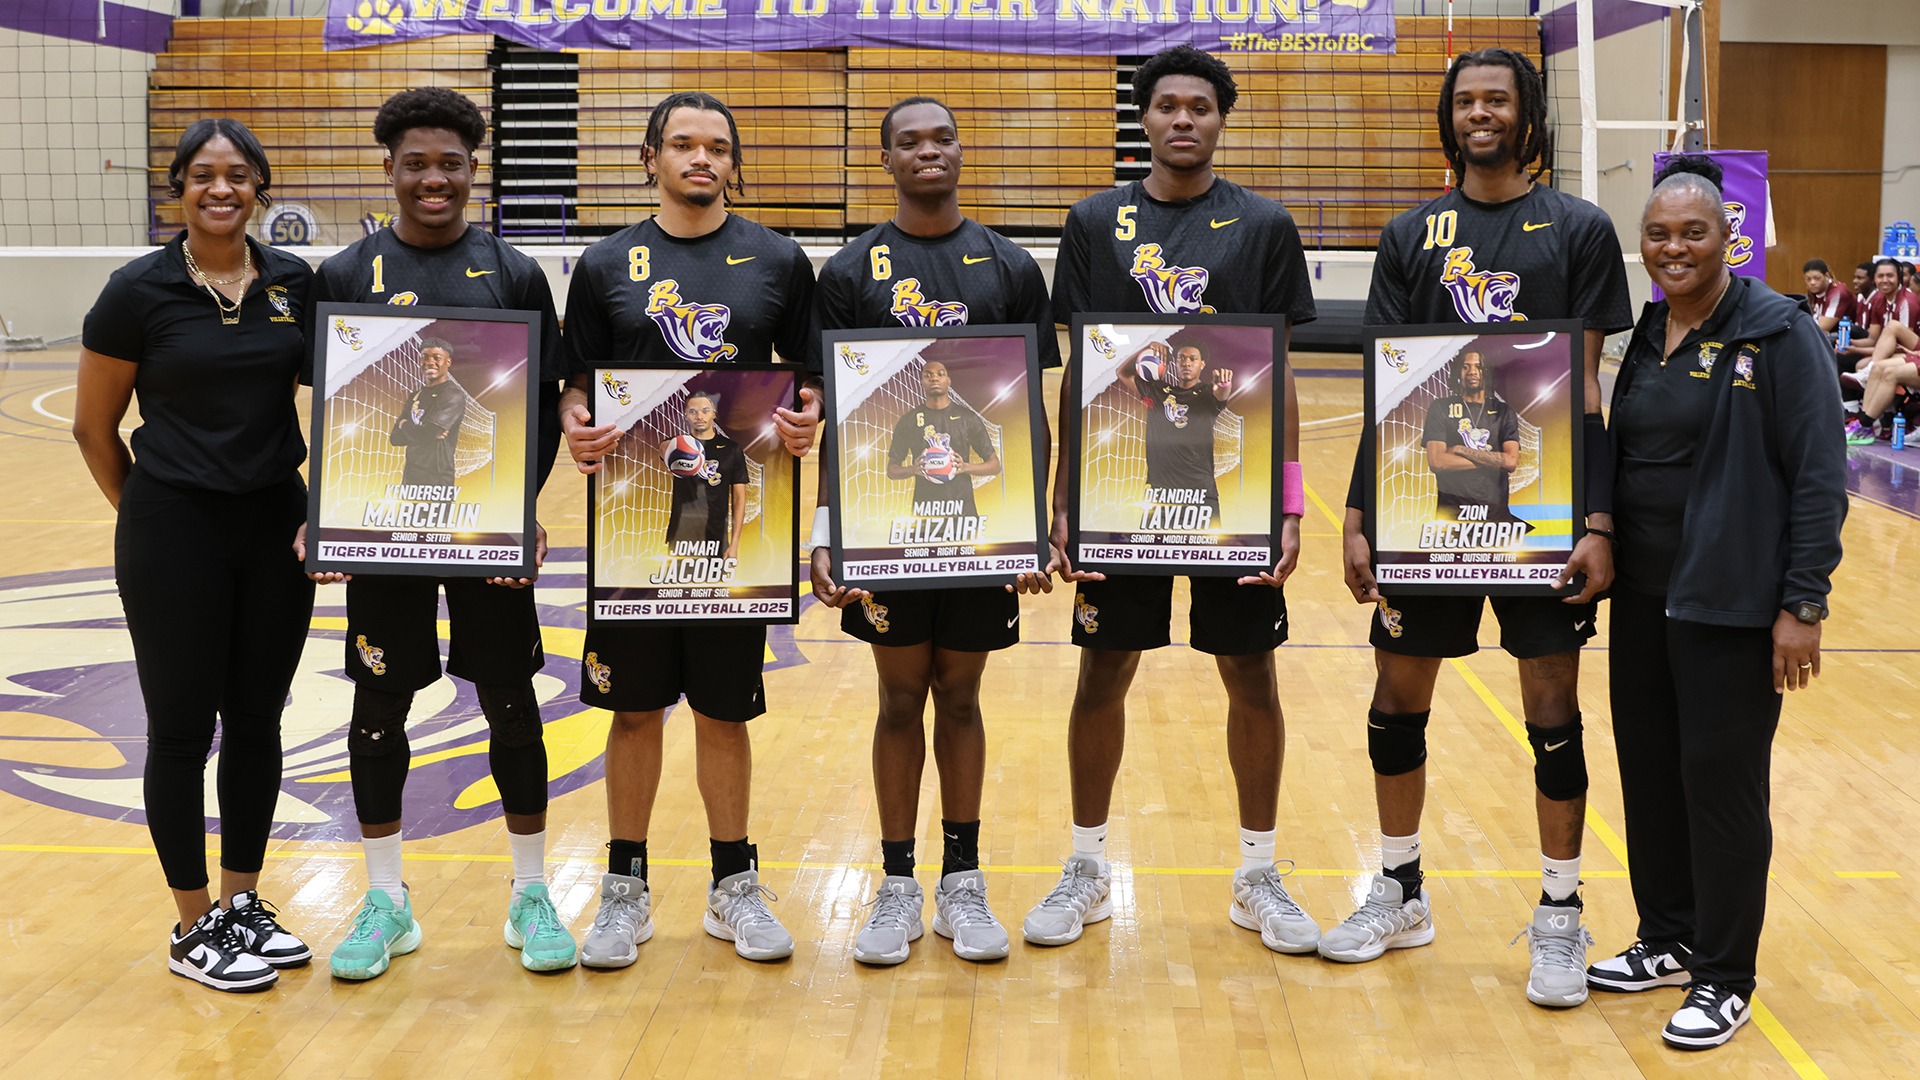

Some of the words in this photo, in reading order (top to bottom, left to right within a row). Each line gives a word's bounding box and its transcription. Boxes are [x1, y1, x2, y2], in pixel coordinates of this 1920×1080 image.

[1228, 32, 1376, 52] #TheBESTofBC
[1115, 205, 1137, 241] 5
[1423, 210, 1458, 250] 10
[275, 221, 305, 243] 50
[628, 245, 650, 282] 8
[870, 245, 892, 281] 6
[371, 255, 385, 293] 1
[1448, 403, 1463, 418] 10
[916, 412, 925, 427] 6
[385, 484, 461, 502] KENDERSLEY
[362, 502, 481, 529] MARCELLIN
[913, 500, 964, 516] MARLON
[1458, 505, 1489, 521] ZION
[1139, 505, 1213, 531] TAYLOR
[391, 532, 418, 542] SENIOR
[425, 533, 452, 543] SETTER
[889, 515, 988, 545] BELIZAIRE
[1419, 522, 1527, 549] BECKFORD
[1130, 534, 1155, 544] SENIOR
[1162, 535, 1187, 544] MIDDLE
[1188, 535, 1218, 545] BLOCKER
[322, 546, 376, 557] TIGERS
[381, 547, 474, 560] VOLLEYBALL
[478, 550, 519, 561] 2025
[669, 540, 720, 556] JOMARI
[904, 548, 929, 558] SENIOR
[937, 547, 957, 557] RIGHT
[960, 546, 976, 556] SIDE
[1083, 548, 1133, 559] TIGERS
[1137, 549, 1225, 561] VOLLEYBALL
[1228, 551, 1267, 562] 2025
[1429, 553, 1455, 563] SENIOR
[1462, 553, 1491, 563] OUTSIDE
[1492, 553, 1517, 563] HITTER
[650, 557, 738, 584] JACOBS
[847, 564, 899, 576] TIGERS
[903, 560, 992, 574] VOLLEYBALL
[995, 559, 1035, 570] 2025
[1380, 568, 1431, 579] TIGERS
[1435, 568, 1525, 579] VOLLEYBALL
[1529, 568, 1564, 579] 202
[657, 589, 683, 598] SENIOR
[691, 588, 712, 598] RIGHT
[714, 588, 730, 598] SIDE
[599, 605, 651, 616] TIGERS
[655, 603, 745, 615] VOLLEYBALL
[749, 602, 789, 614] 2025
